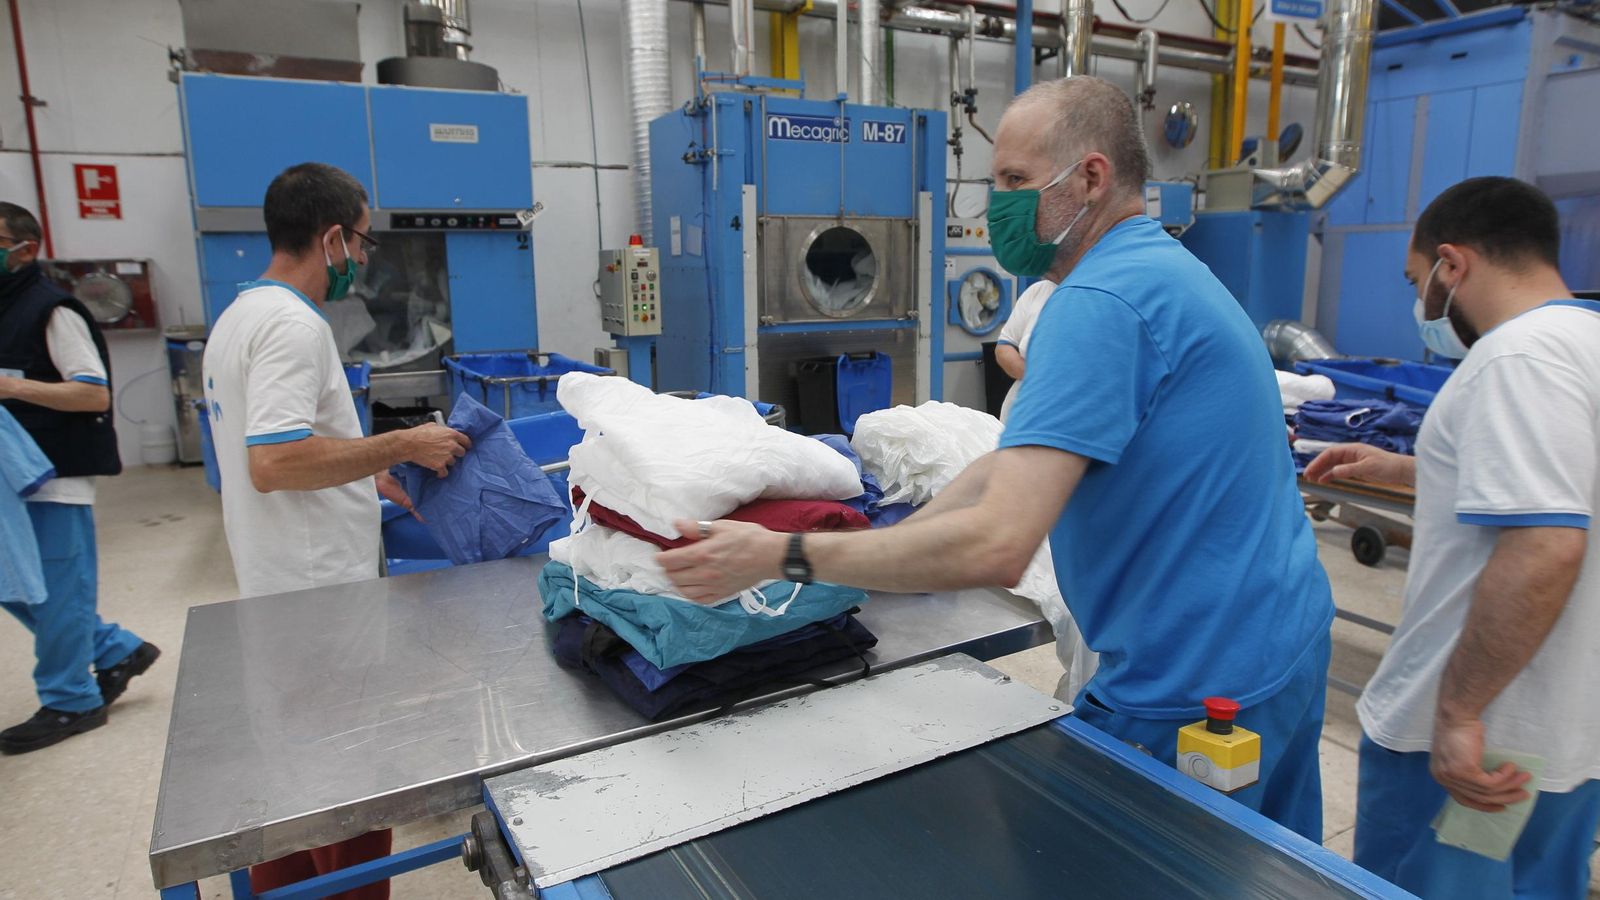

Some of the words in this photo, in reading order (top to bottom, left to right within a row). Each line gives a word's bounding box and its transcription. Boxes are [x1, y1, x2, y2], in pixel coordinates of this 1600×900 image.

[863, 122, 905, 142] M-87
[730, 215, 741, 231] 4
[516, 233, 528, 250] 2
